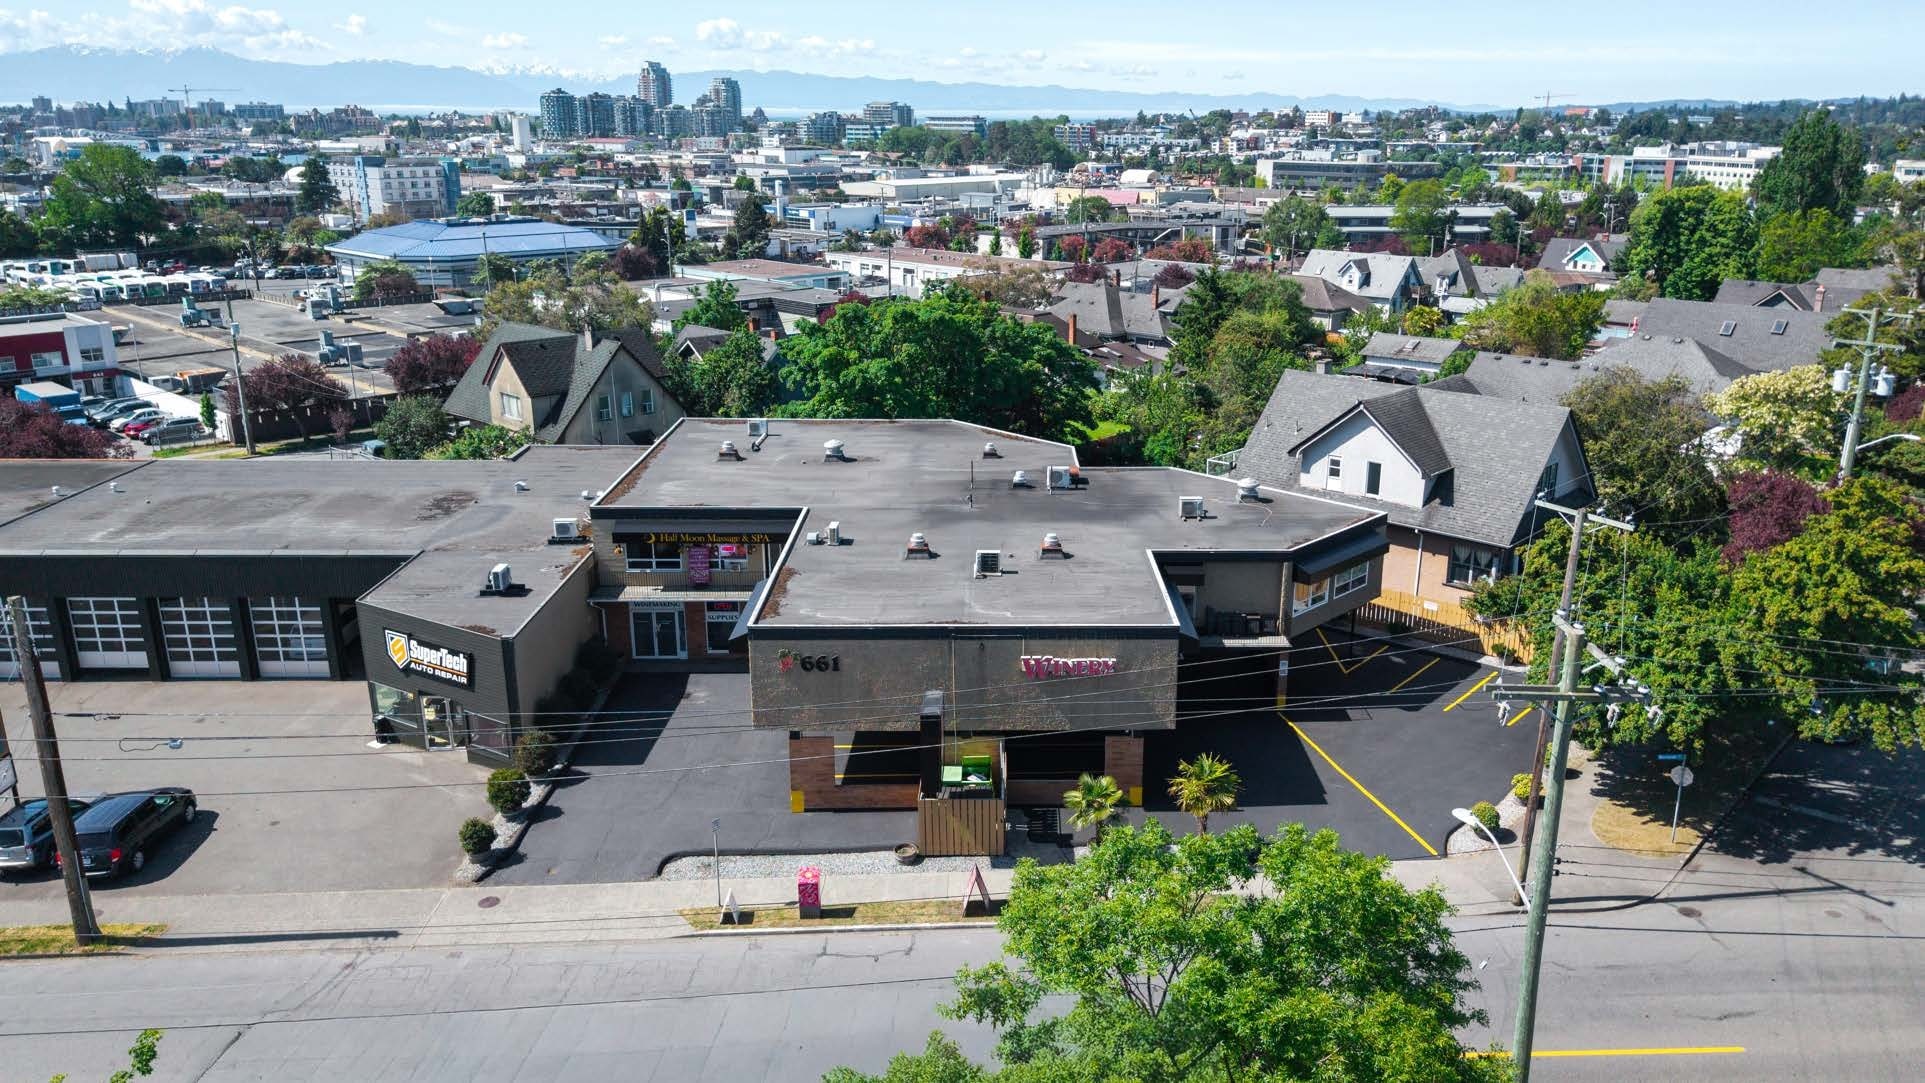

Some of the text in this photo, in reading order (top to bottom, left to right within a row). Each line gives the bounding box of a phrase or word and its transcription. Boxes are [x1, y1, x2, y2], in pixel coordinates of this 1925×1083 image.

[680, 533, 705, 543] Moon
[707, 533, 740, 544] Massage
[741, 533, 750, 543] &
[751, 533, 769, 543] SPA
[410, 639, 467, 673] SuperTech
[800, 655, 841, 672] 661
[409, 662, 468, 685] AUTO REPAIR
[1020, 656, 1116, 680] WINERY
